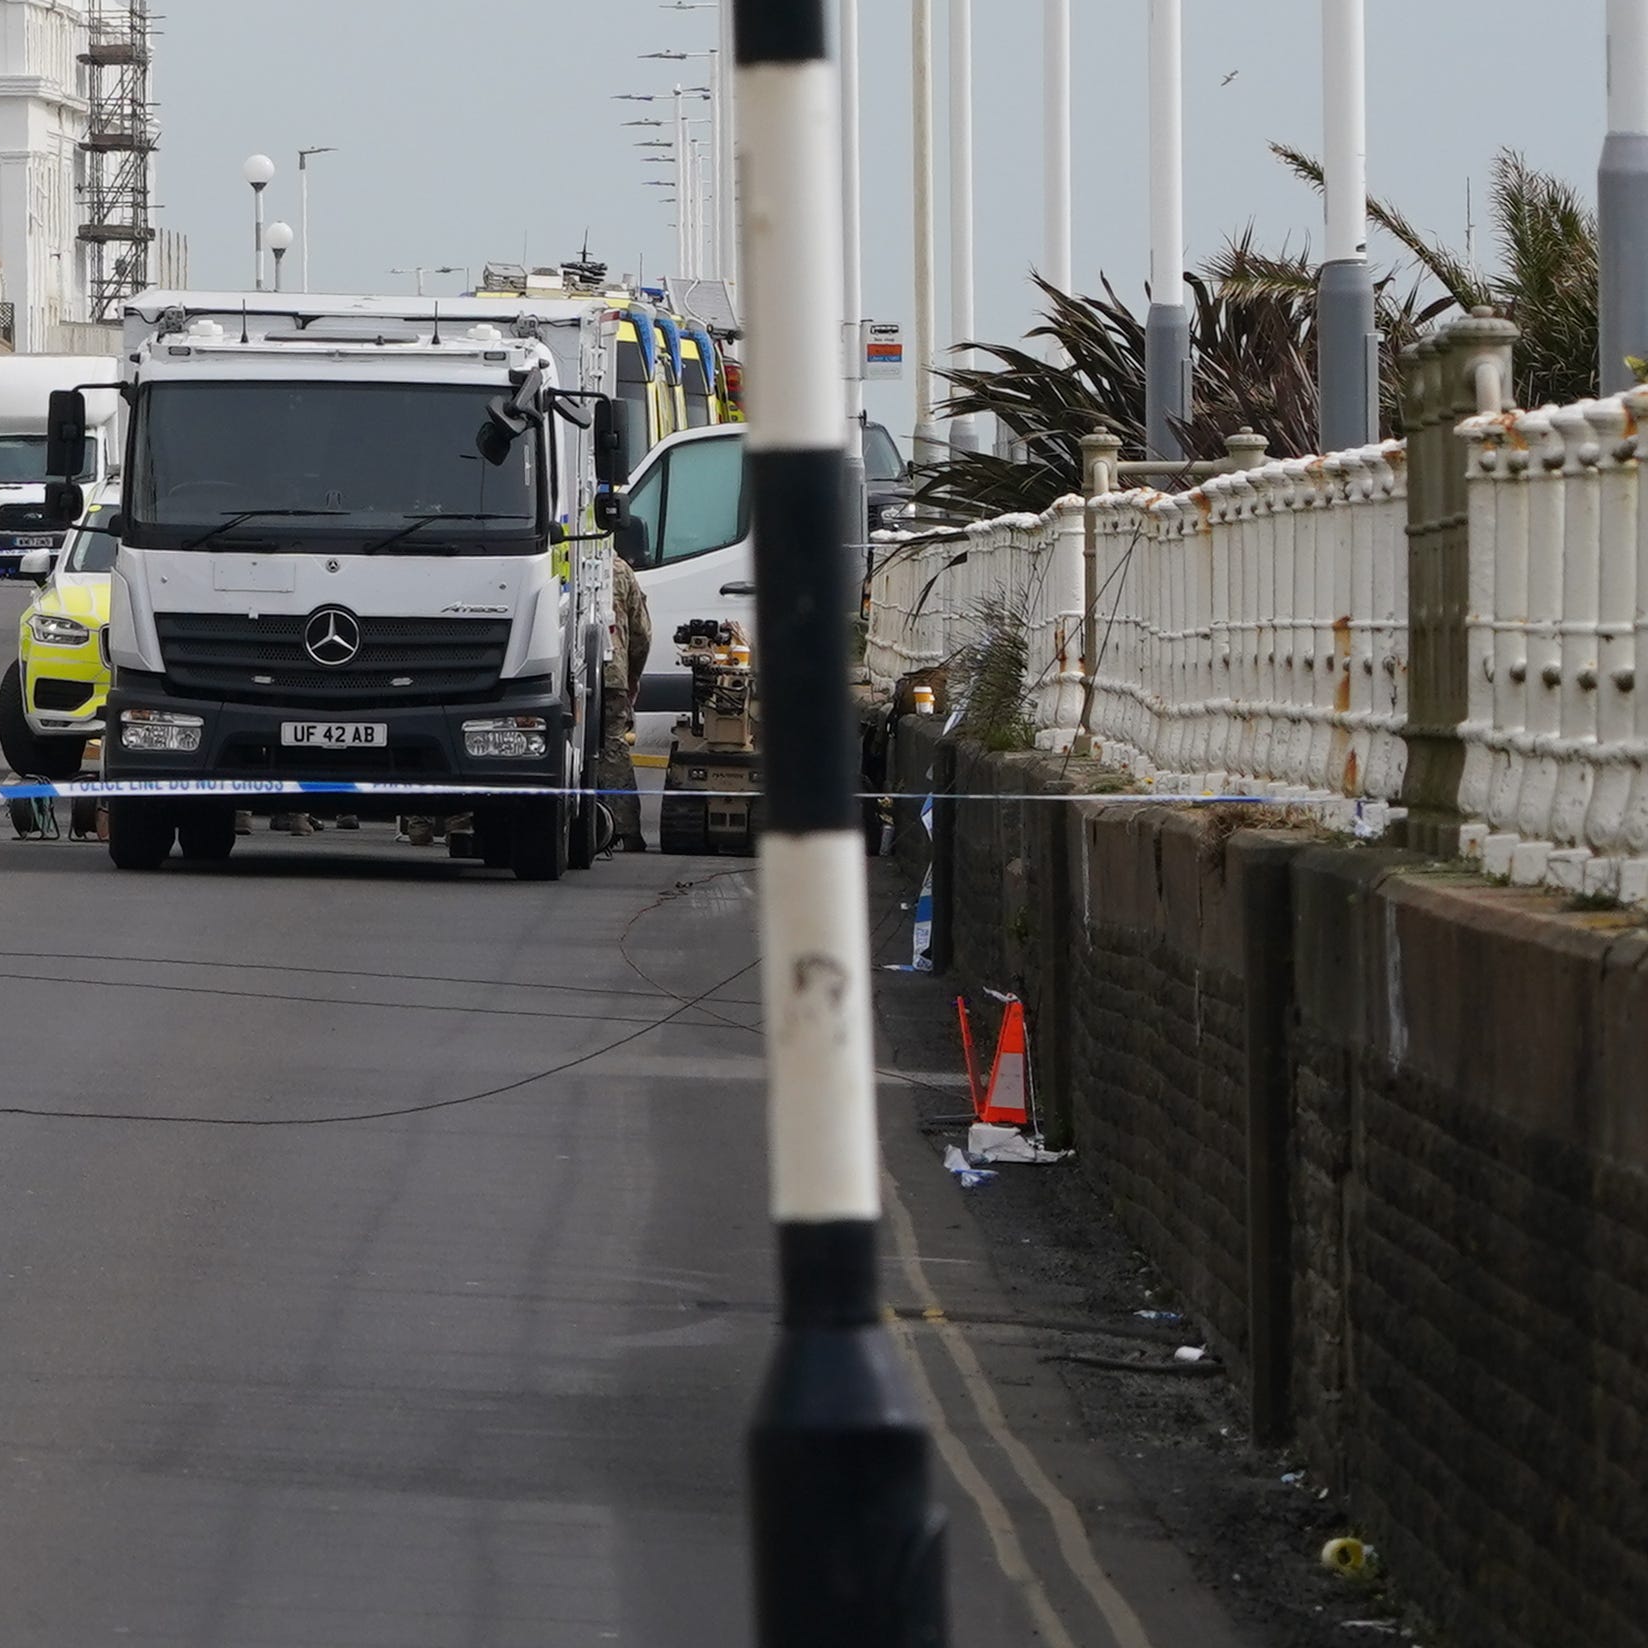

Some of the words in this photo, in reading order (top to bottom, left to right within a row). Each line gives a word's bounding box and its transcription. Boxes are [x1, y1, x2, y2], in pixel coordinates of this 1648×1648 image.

[294, 725, 317, 742] UF
[323, 726, 346, 743] 42
[352, 726, 375, 743] AB
